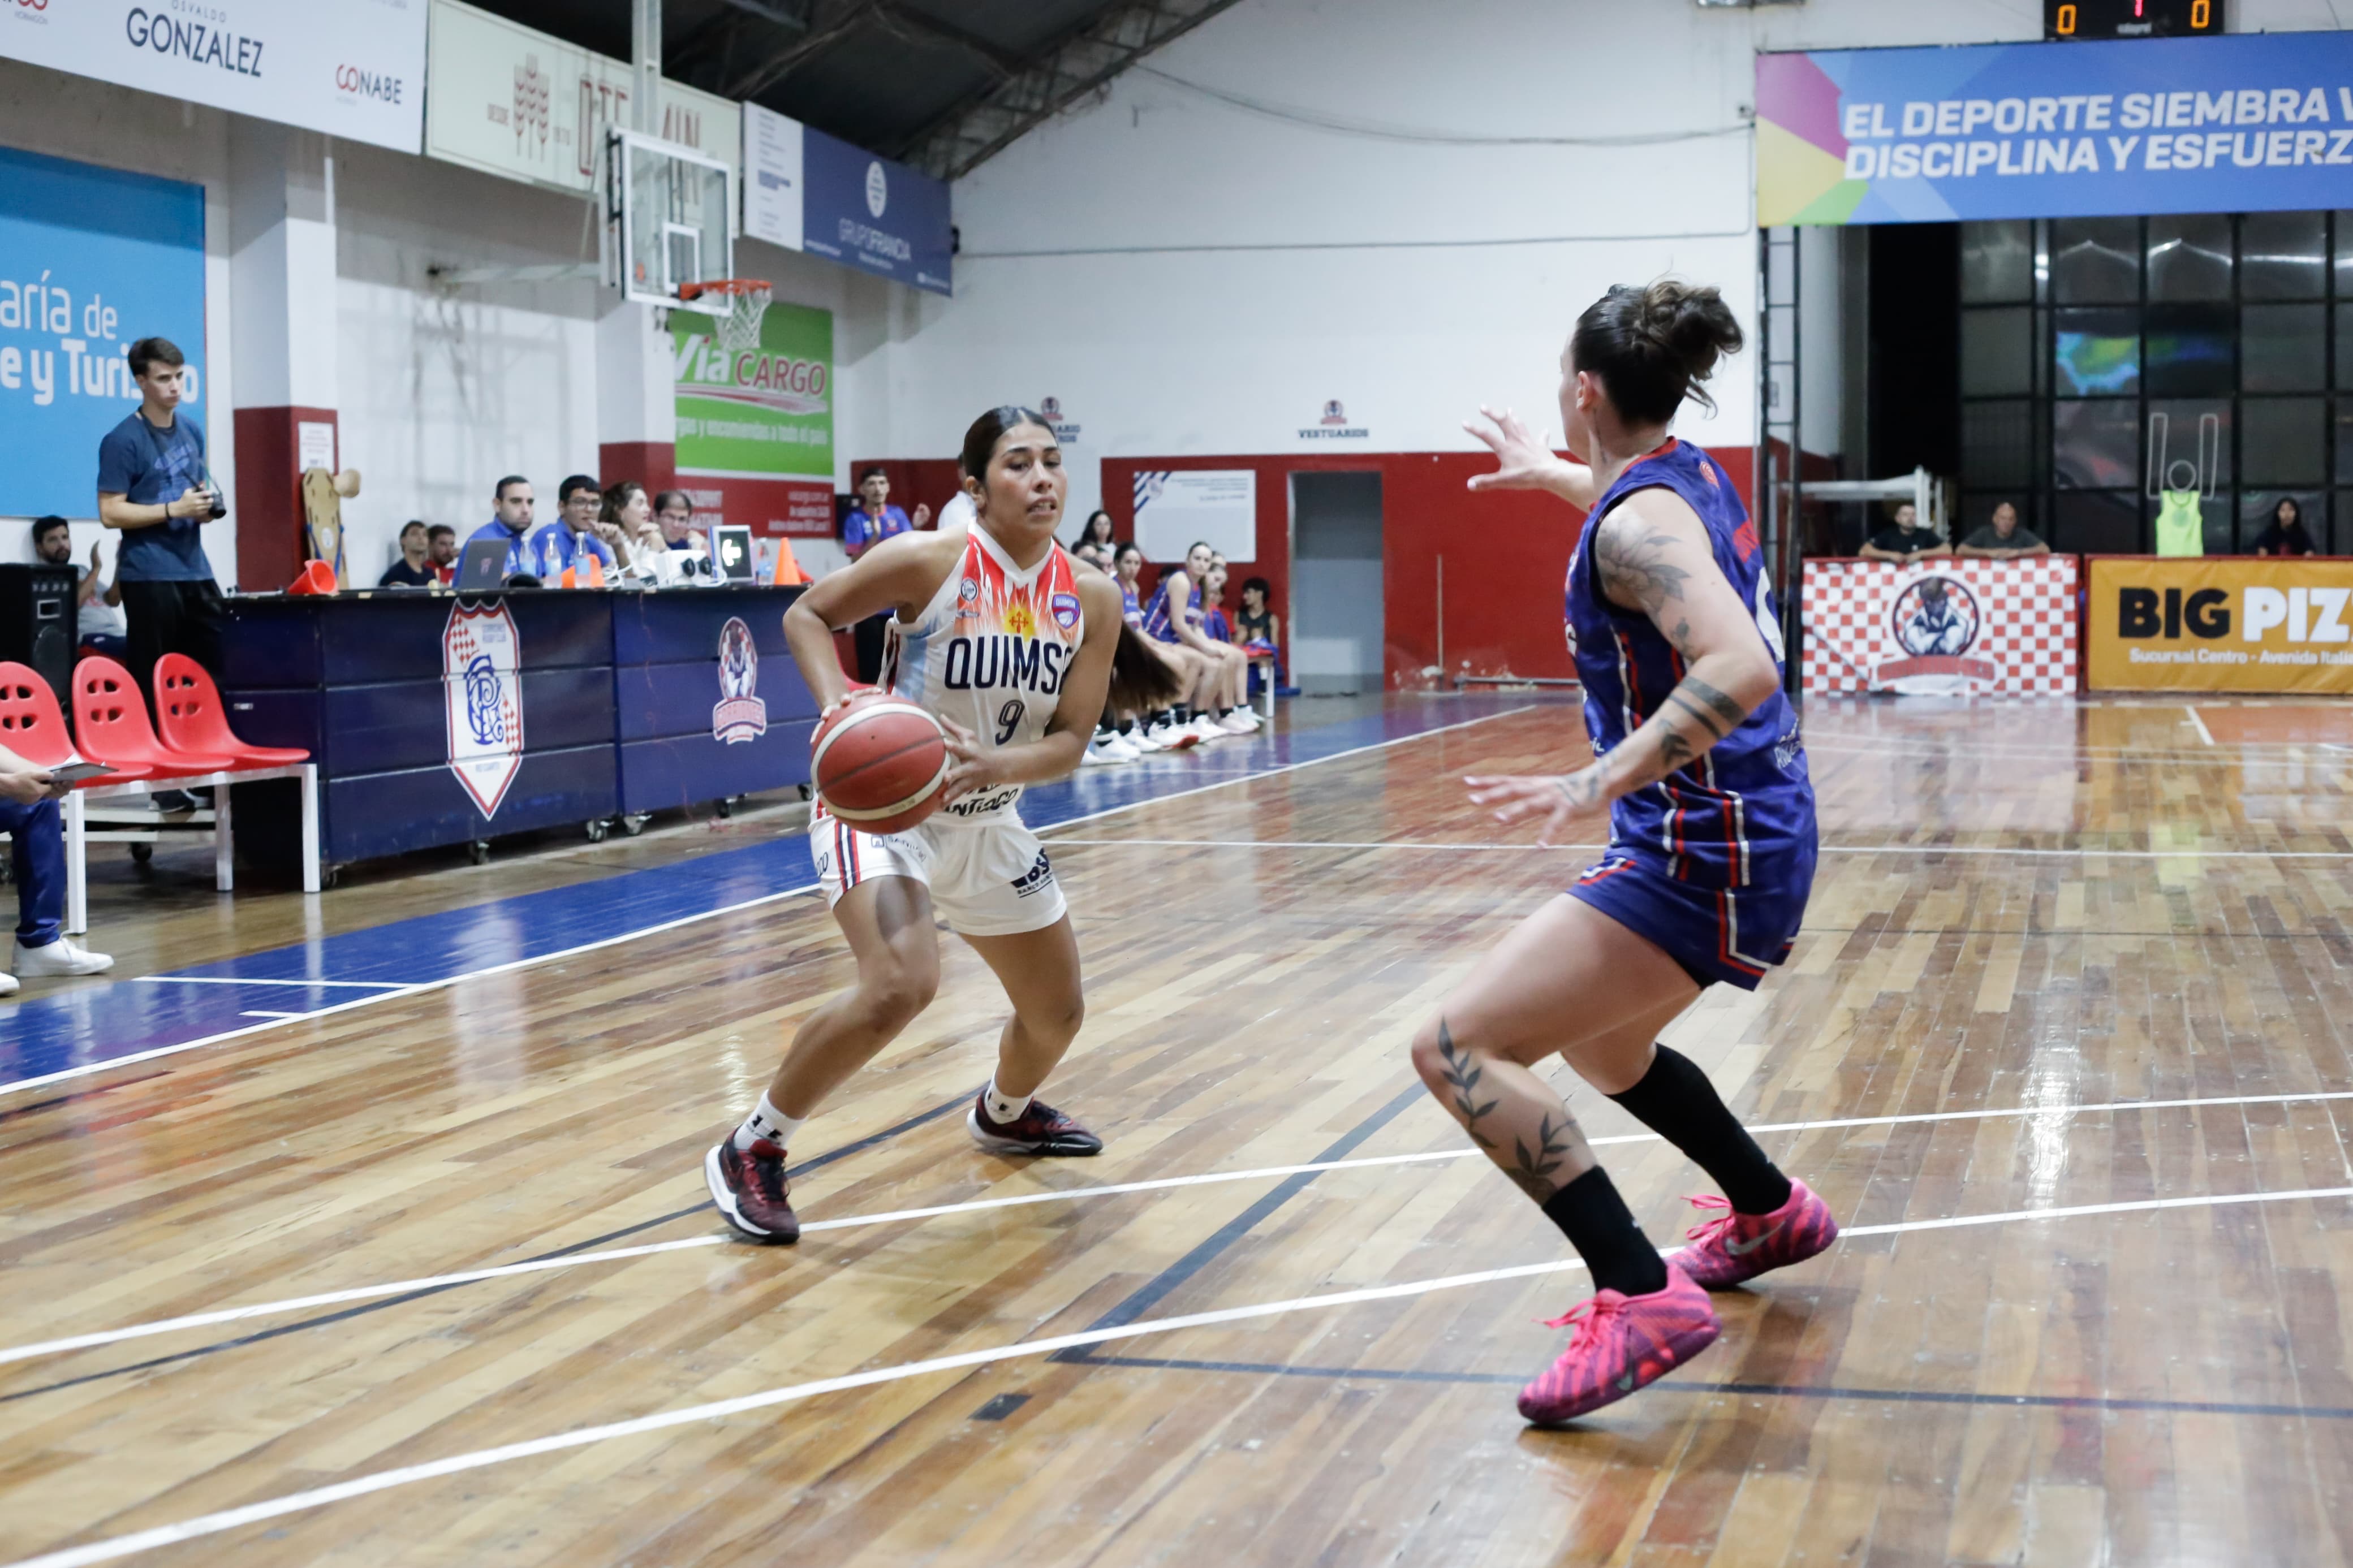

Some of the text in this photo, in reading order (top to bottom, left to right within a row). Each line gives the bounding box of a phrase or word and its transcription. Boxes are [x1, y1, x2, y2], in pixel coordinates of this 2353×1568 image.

[2057, 5, 2076, 34] 0
[2191, 0, 2210, 28] 0
[127, 7, 263, 77] GONZALEZ
[336, 64, 402, 105] CONABE
[1845, 103, 1895, 139] EL
[1902, 95, 2113, 137] DEPORTE
[2119, 87, 2330, 129] SIEMBRA
[1845, 129, 2353, 180] DISCIPLINA Y ESFUERZ
[84, 293, 117, 339] de
[31, 349, 54, 406] y
[61, 338, 199, 403] Turio
[737, 353, 826, 395] CARGO
[2119, 588, 2231, 639] BIG
[2130, 648, 2195, 664] Sucursal
[2197, 649, 2248, 664] Centro
[2260, 650, 2318, 665] Avenida
[996, 699, 1025, 746] 9
